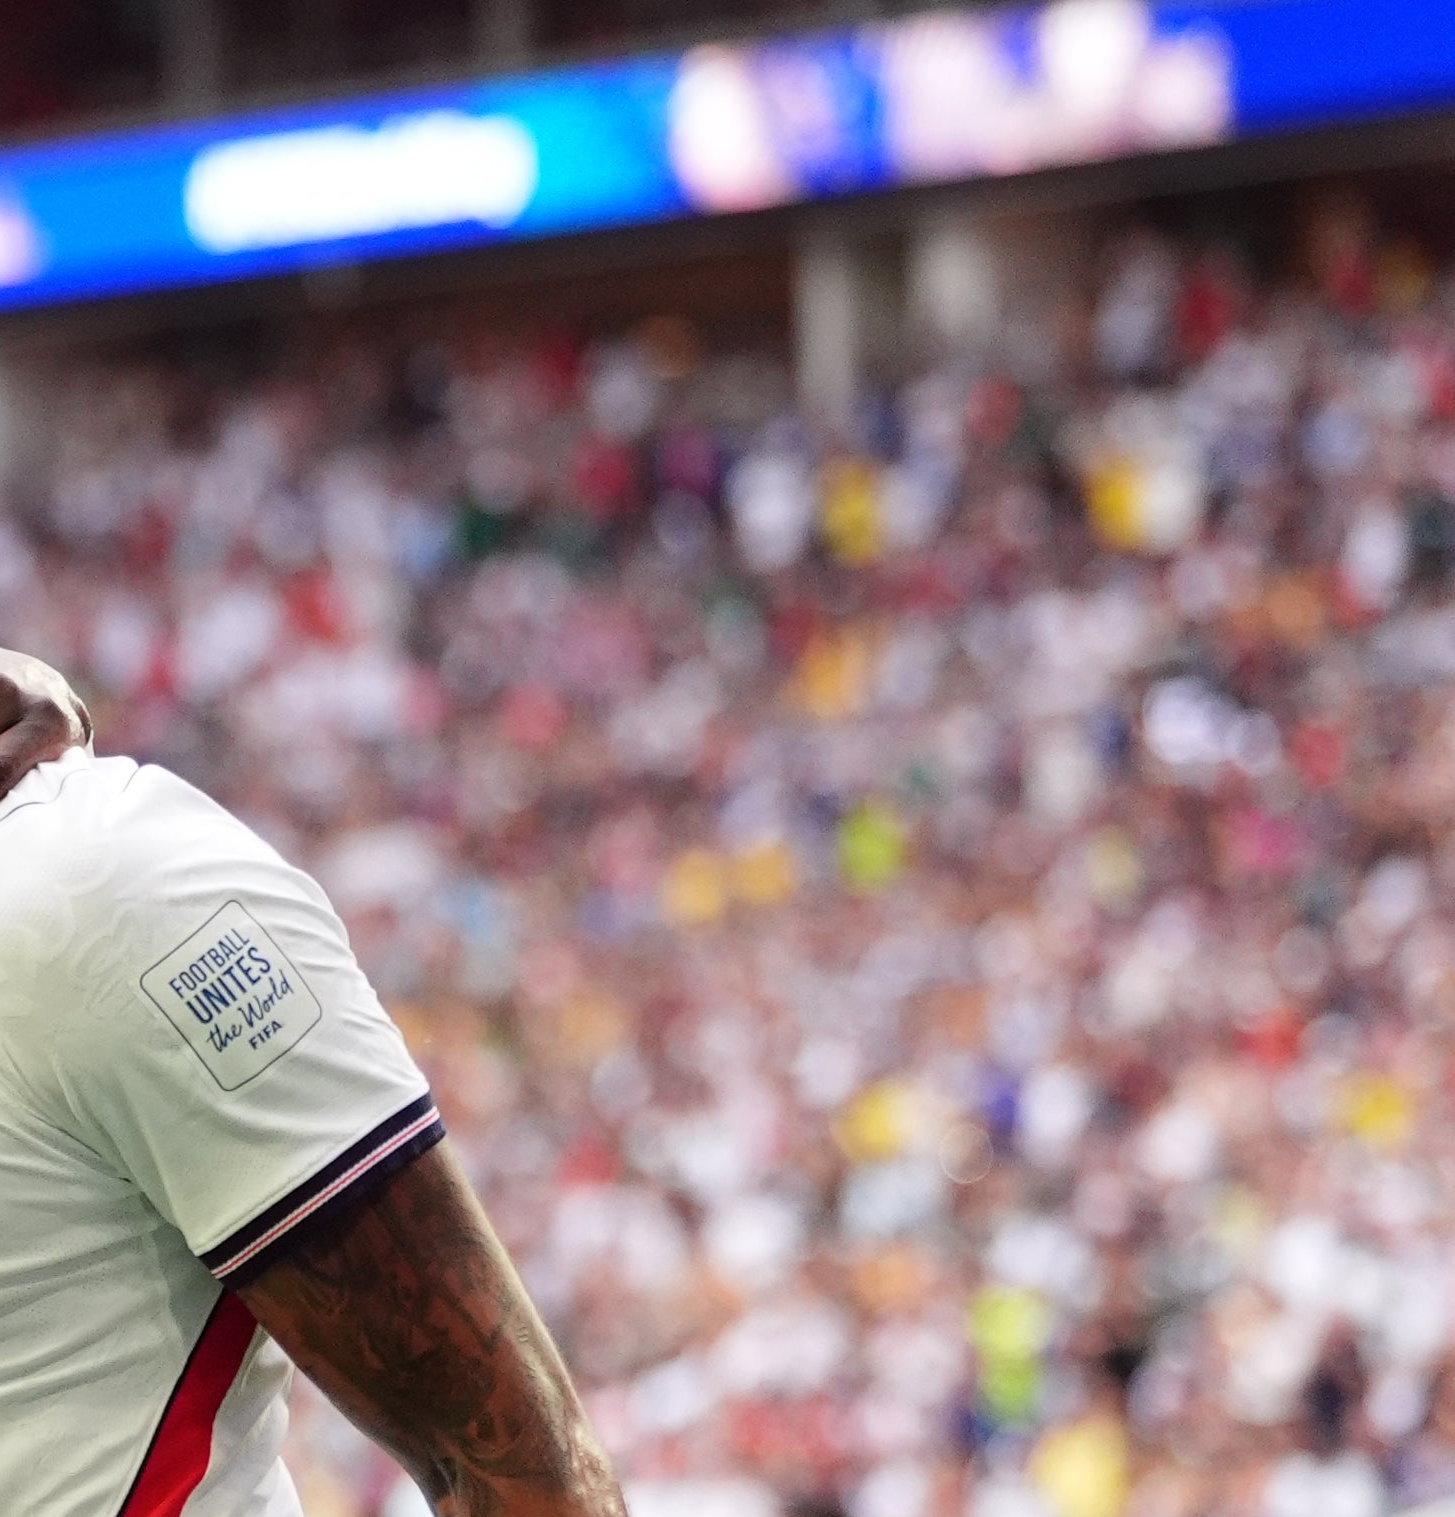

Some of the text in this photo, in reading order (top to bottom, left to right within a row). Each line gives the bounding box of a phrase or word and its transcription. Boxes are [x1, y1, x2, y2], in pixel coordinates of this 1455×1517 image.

[168, 928, 250, 999] FOOTBALL
[185, 946, 272, 1024] UNITES
[206, 969, 295, 1053] the World
[248, 1019, 283, 1051] FIFA
